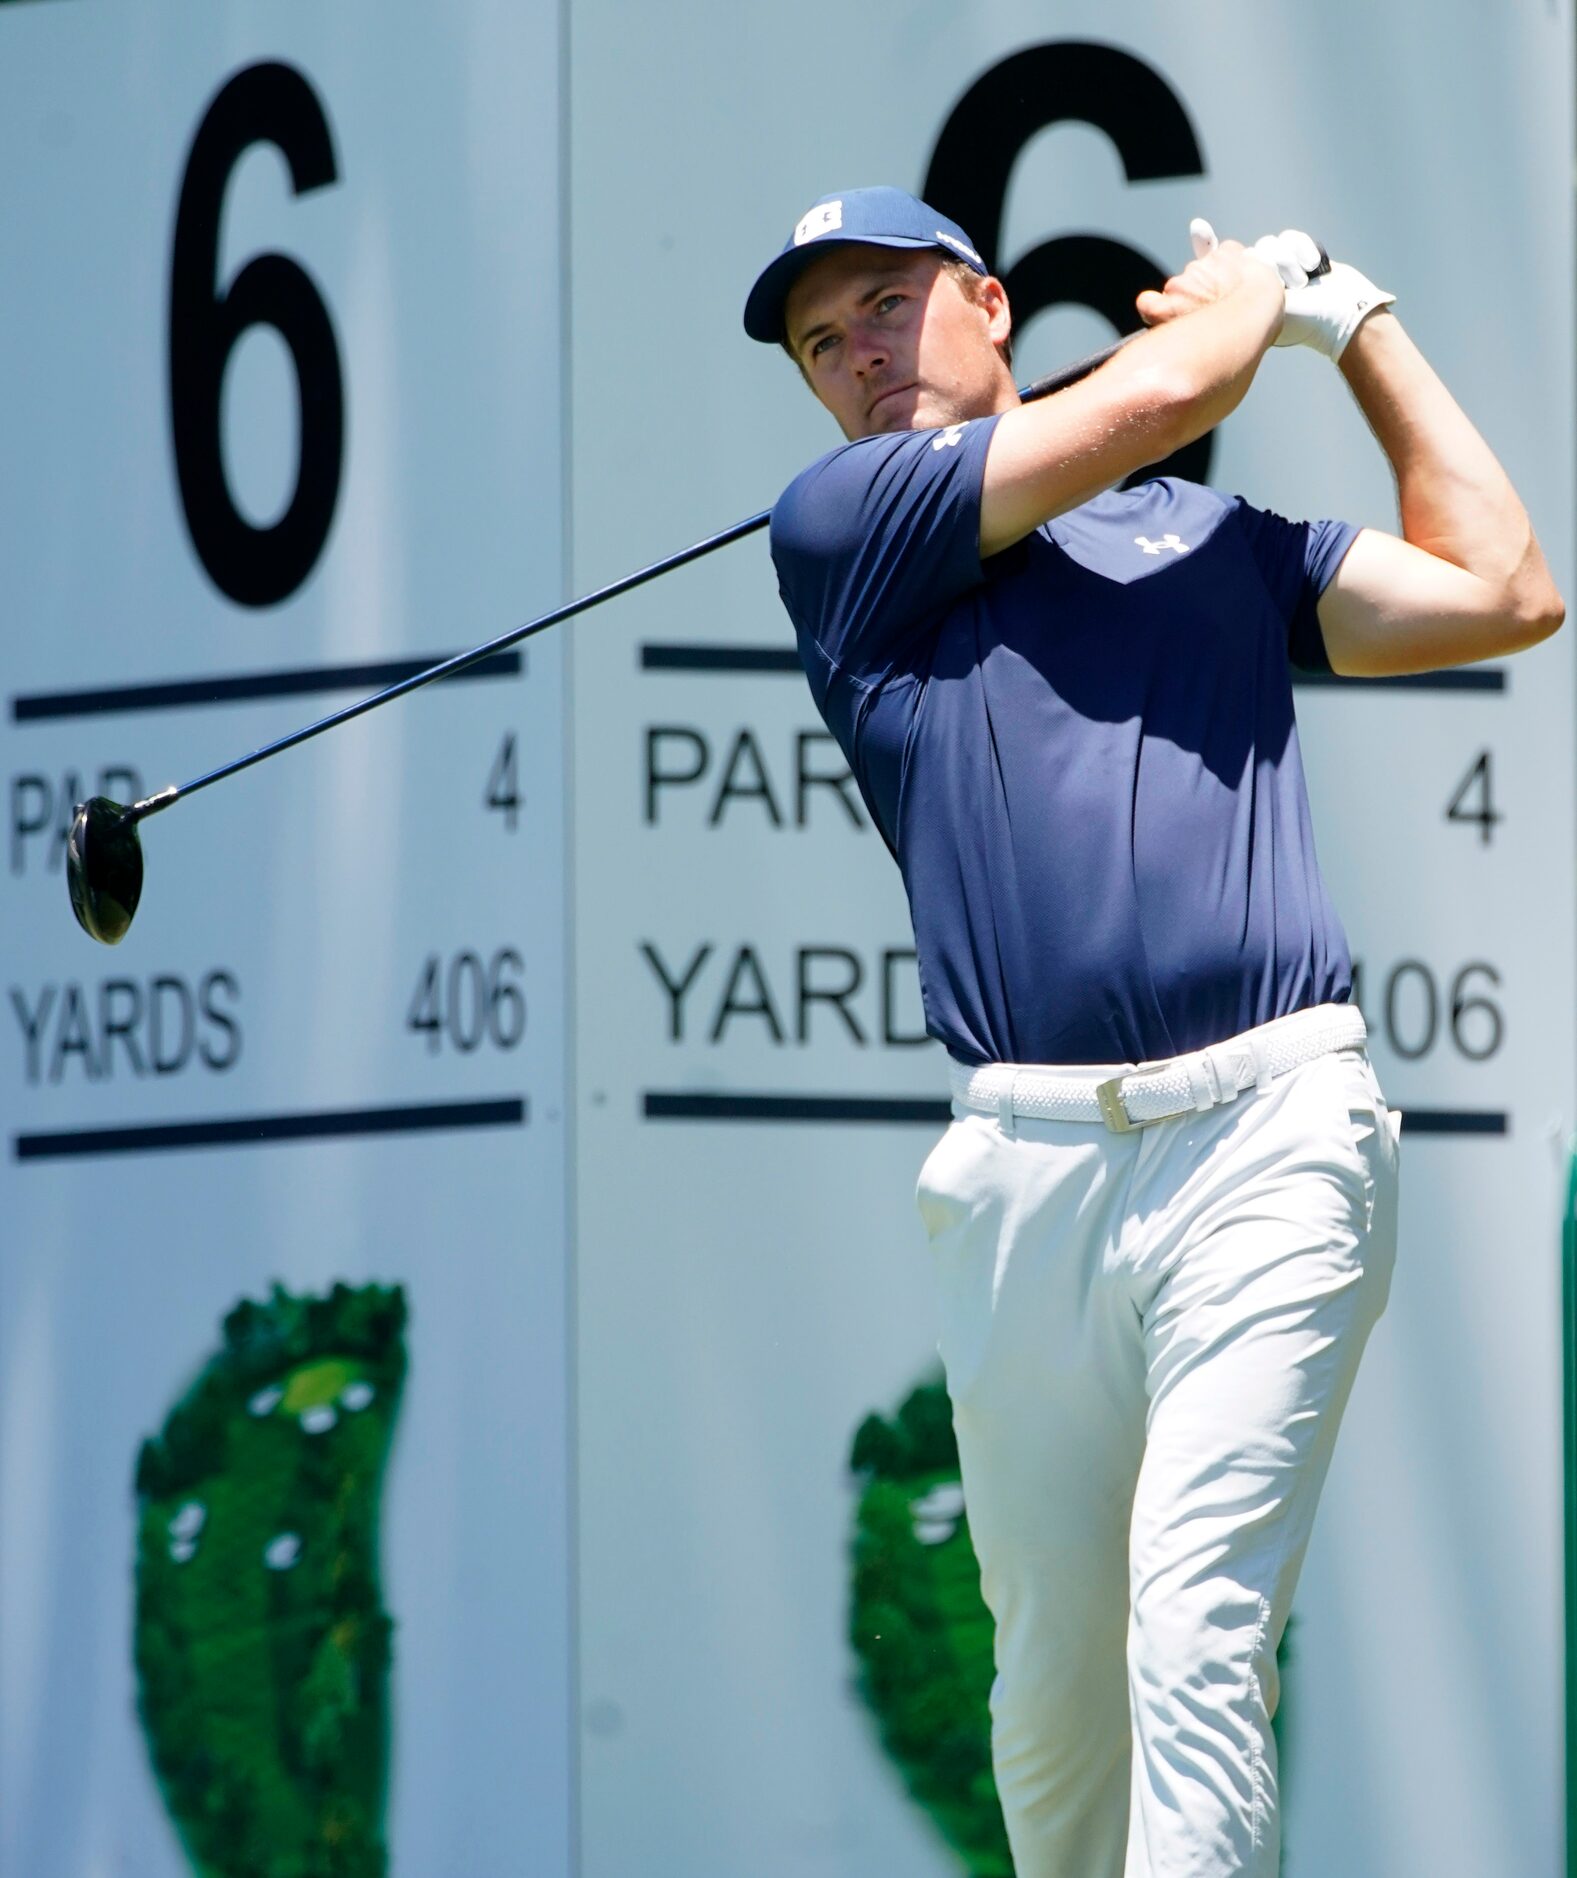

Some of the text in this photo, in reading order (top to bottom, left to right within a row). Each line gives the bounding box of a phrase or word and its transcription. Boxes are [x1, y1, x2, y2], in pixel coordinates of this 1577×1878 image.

[163, 57, 347, 612] 6
[484, 733, 523, 829] 4
[642, 724, 1503, 847] PAR 4
[10, 947, 527, 1083] YARDS 406
